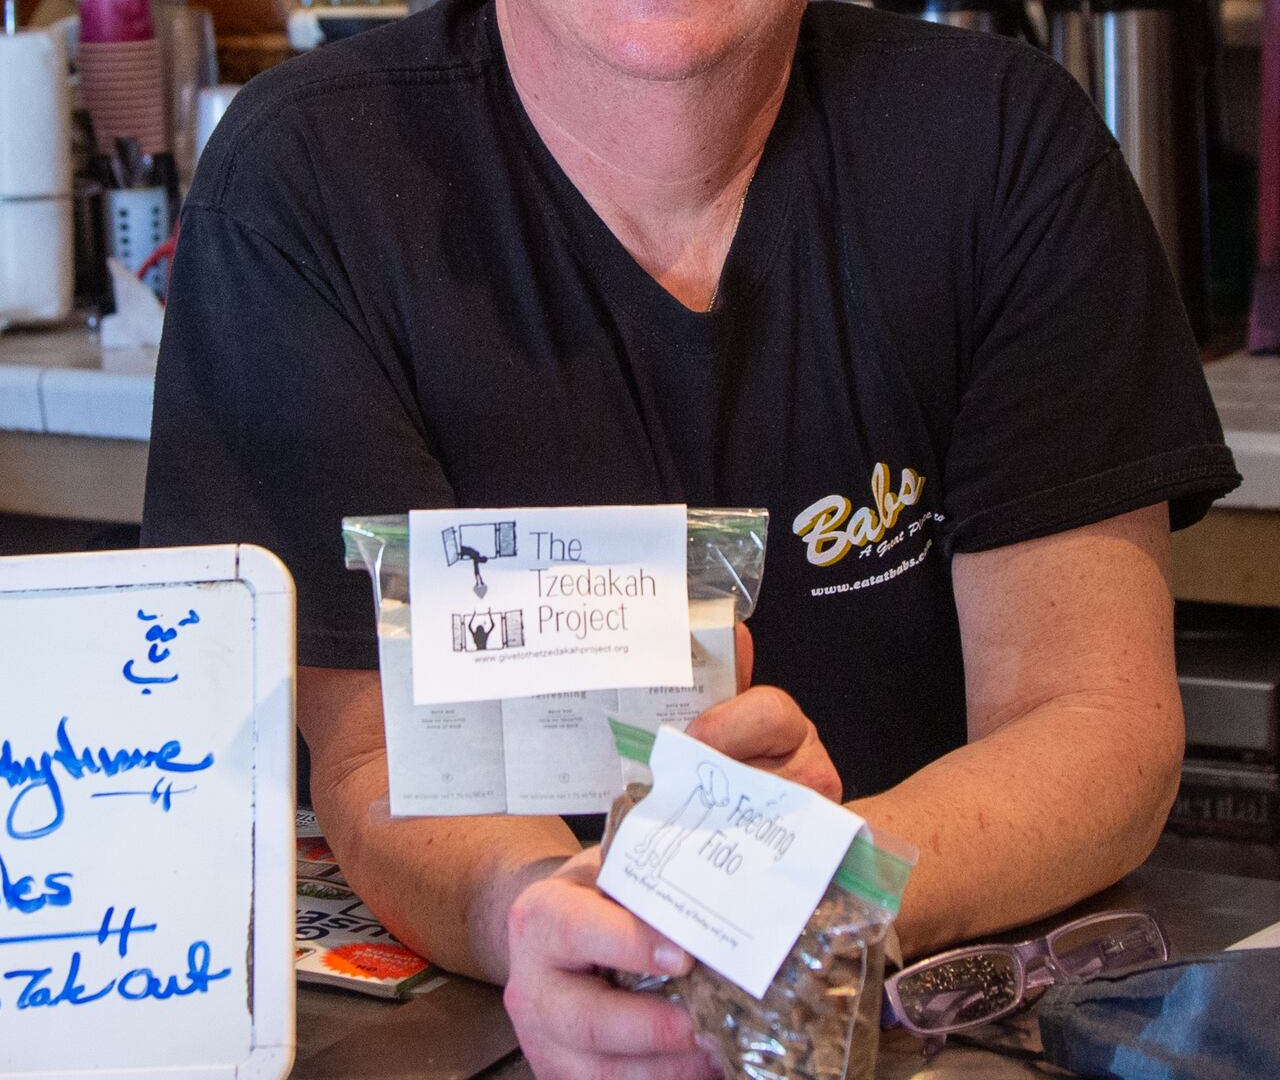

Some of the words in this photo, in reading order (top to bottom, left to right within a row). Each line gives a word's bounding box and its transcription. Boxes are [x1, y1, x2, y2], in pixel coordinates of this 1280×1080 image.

[792, 462, 926, 567] Babs
[859, 544, 872, 559] A
[934, 513, 945, 522] to
[529, 531, 584, 561] The
[529, 568, 656, 597] Tzedakah
[538, 602, 628, 639] Project
[474, 644, 629, 664] www.givetothetzedakahproject.org
[728, 794, 796, 862] Feeding
[698, 829, 744, 876] Fido
[119, 940, 232, 1000] Out
